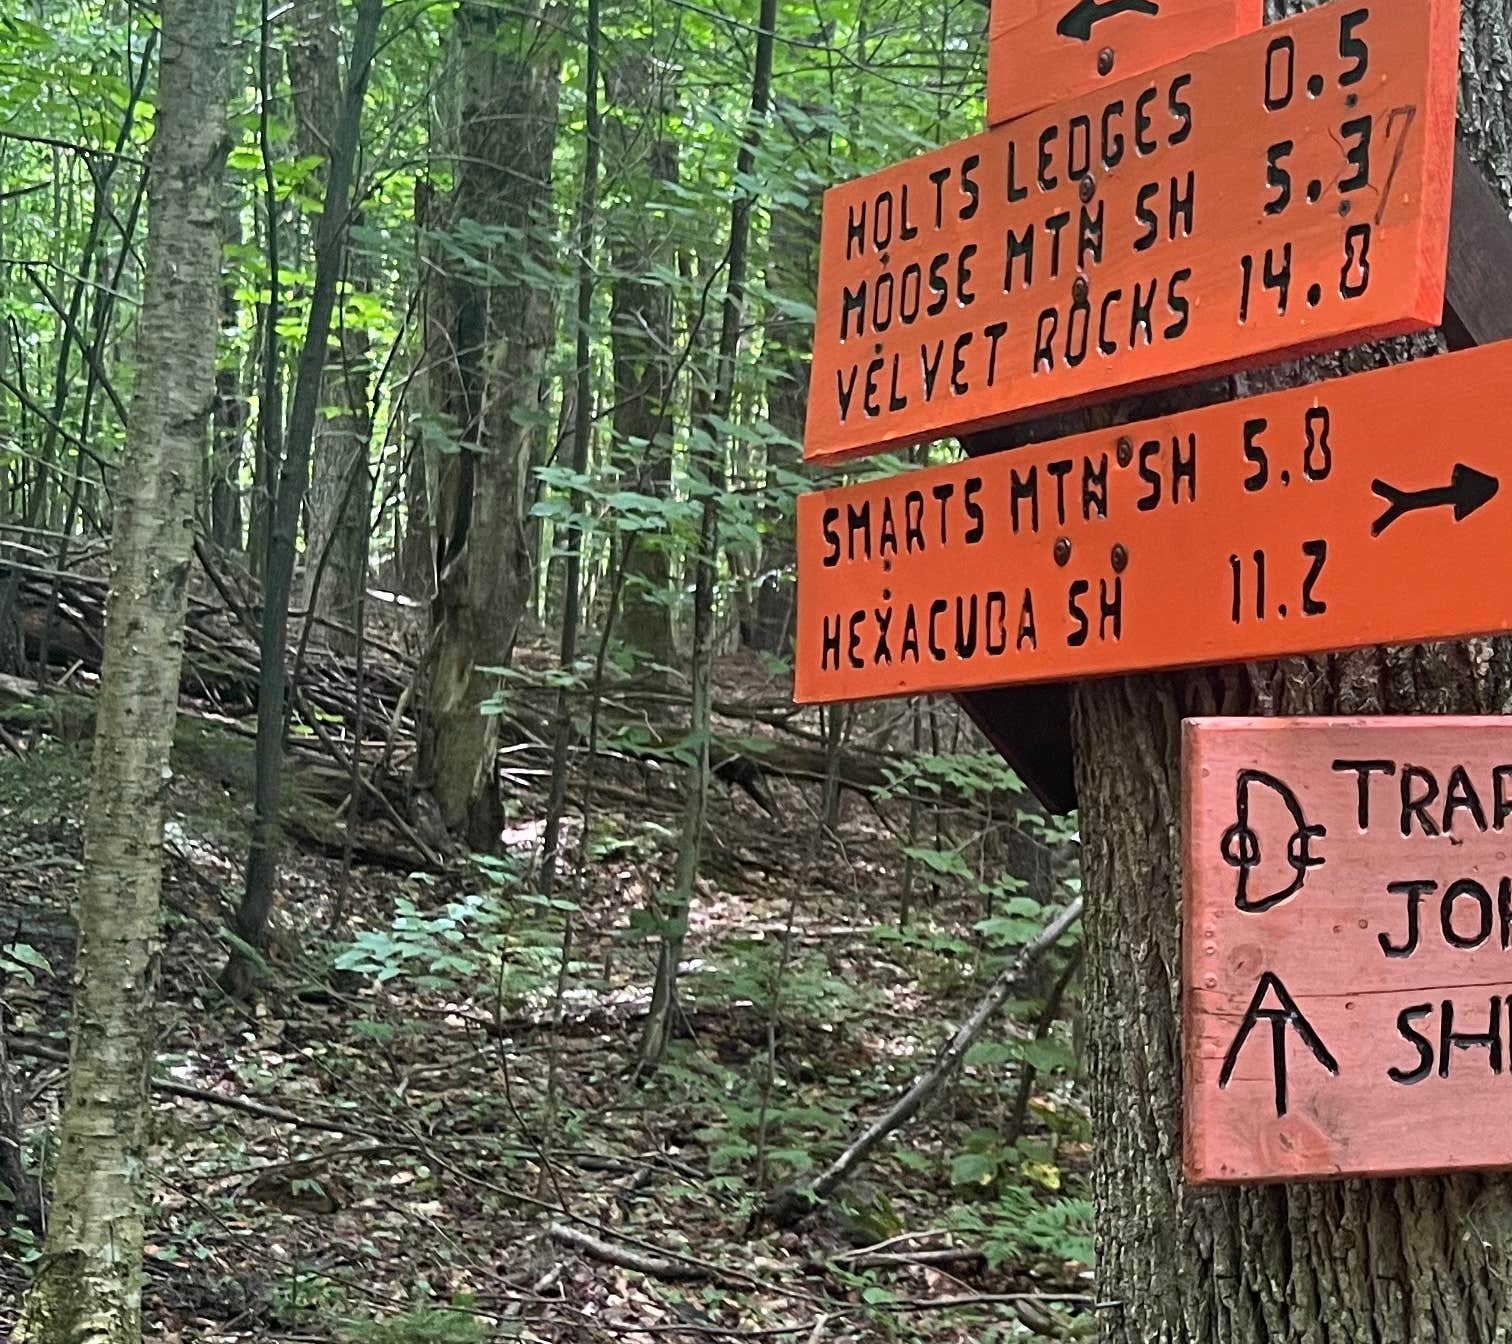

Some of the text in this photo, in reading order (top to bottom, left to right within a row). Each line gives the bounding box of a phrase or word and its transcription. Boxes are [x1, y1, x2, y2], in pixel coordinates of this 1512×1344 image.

[847, 8, 1369, 261] HOLTS LEDGES 0.5
[837, 223, 1371, 423] VELVET ROCKS 14.8
[839, 243, 977, 343] MOOSE
[1003, 199, 1104, 294] MTN
[1132, 170, 1195, 253] SH
[822, 405, 1332, 567] SMARTS MTN SH 5.8
[820, 539, 1328, 671] HEXACUBA SH 11.2
